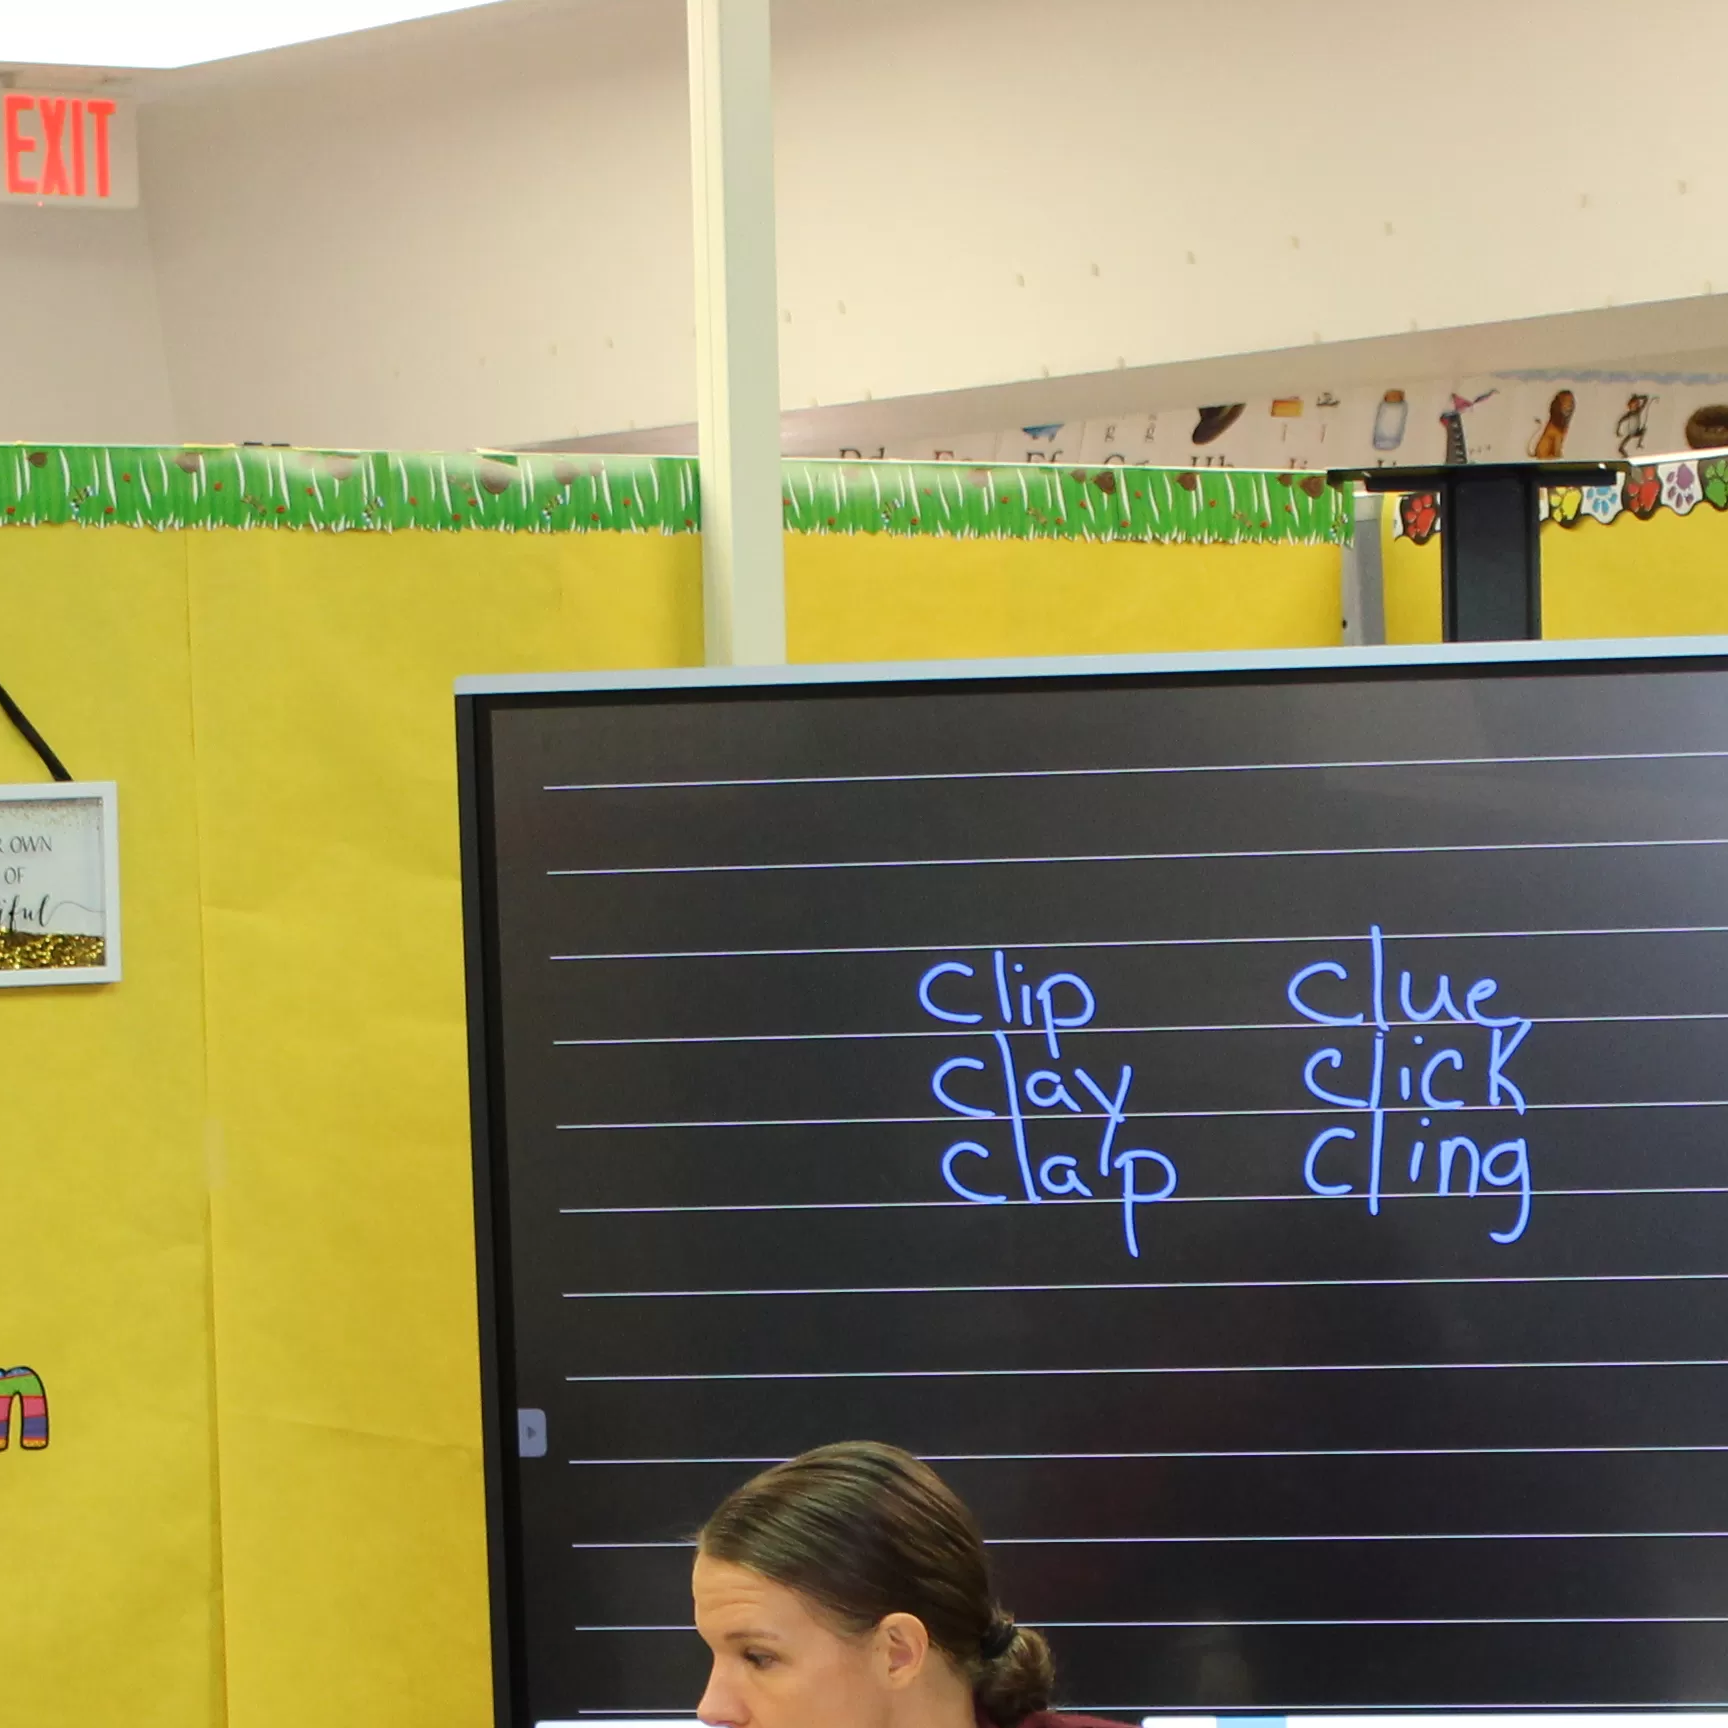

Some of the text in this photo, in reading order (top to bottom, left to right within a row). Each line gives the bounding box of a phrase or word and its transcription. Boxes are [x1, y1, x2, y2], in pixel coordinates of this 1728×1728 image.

[4, 94, 116, 198] EXIT
[3, 867, 25, 885] OF
[10, 834, 52, 854] OWN
[918, 925, 1522, 1059] clip clue
[932, 1030, 1132, 1176] clay
[942, 1107, 1532, 1258] clap cling
